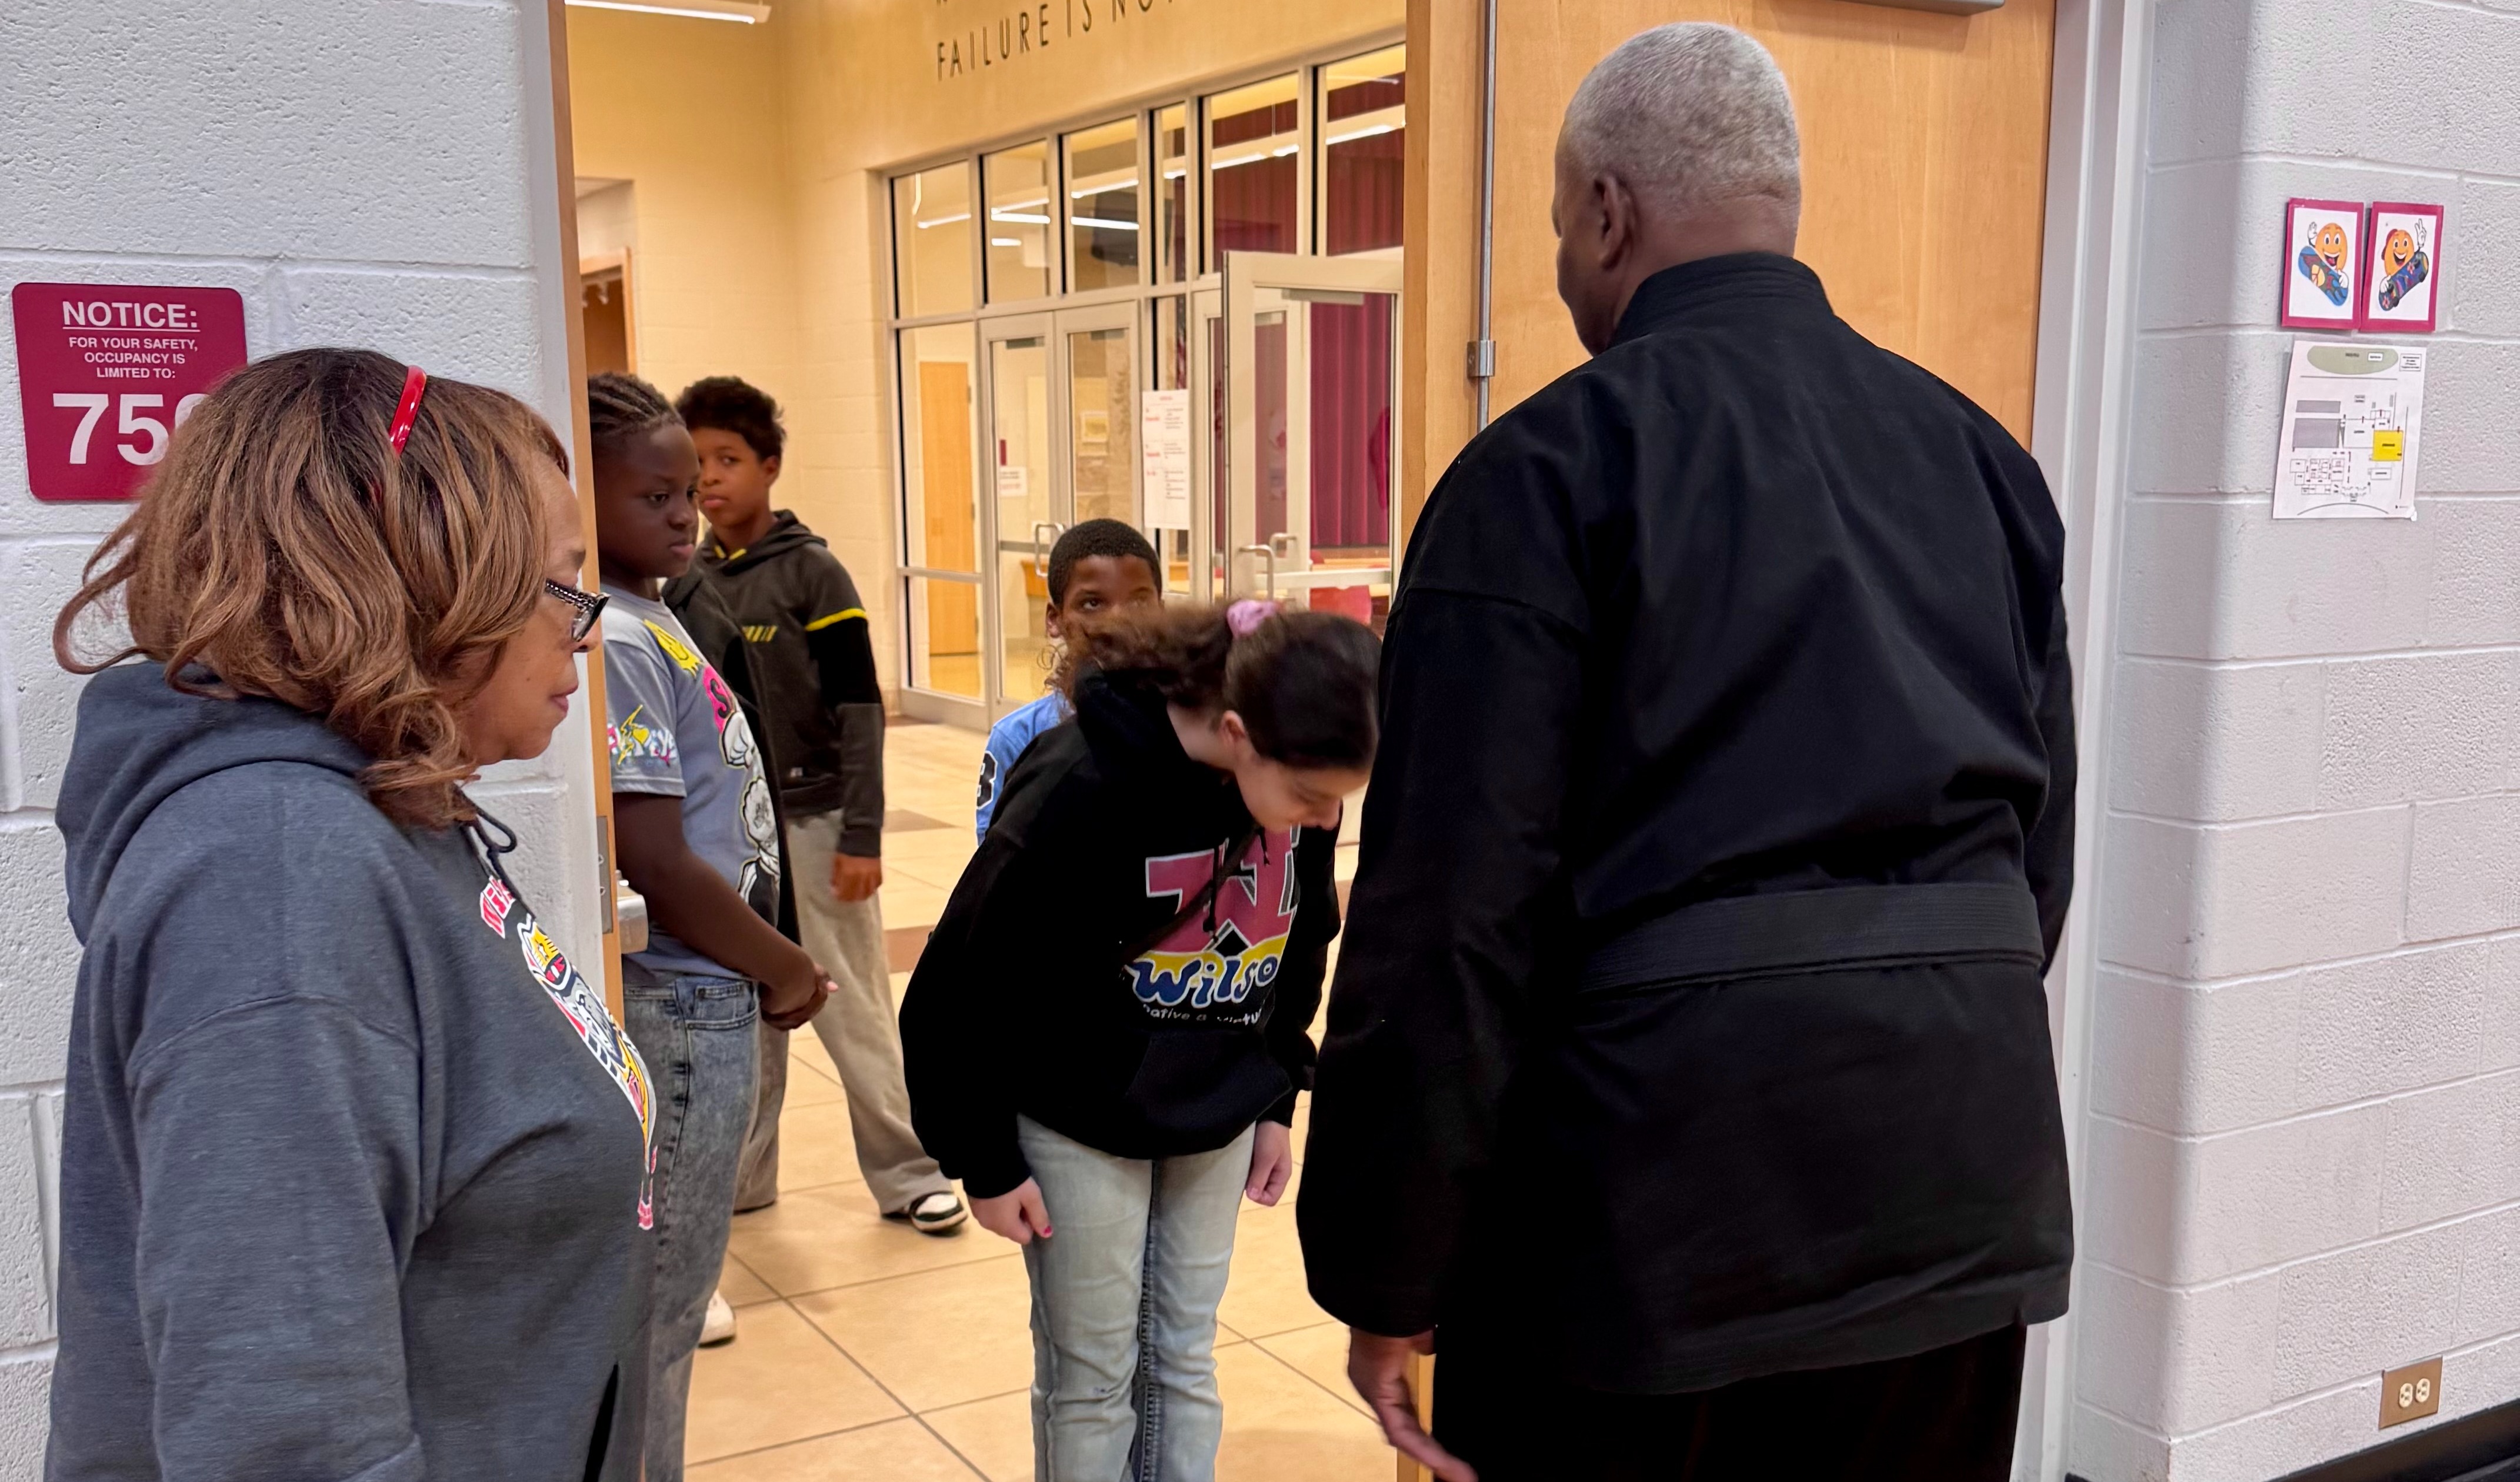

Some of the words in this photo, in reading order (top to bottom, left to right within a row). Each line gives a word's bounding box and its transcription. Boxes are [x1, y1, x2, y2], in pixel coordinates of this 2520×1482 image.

[937, 4, 1049, 81] FAILURE
[1066, 0, 1092, 38] IS
[62, 301, 198, 328] NOTICE:
[69, 337, 97, 348] FOR
[101, 338, 140, 349] YOUR
[144, 338, 198, 352] SAFETY,
[84, 352, 168, 364] OCCUPANCY
[172, 353, 185, 364] IS
[96, 367, 150, 378] LIMITED
[153, 368, 176, 379] TO:
[53, 393, 209, 466] 75
[1125, 956, 1281, 1008] Wilso
